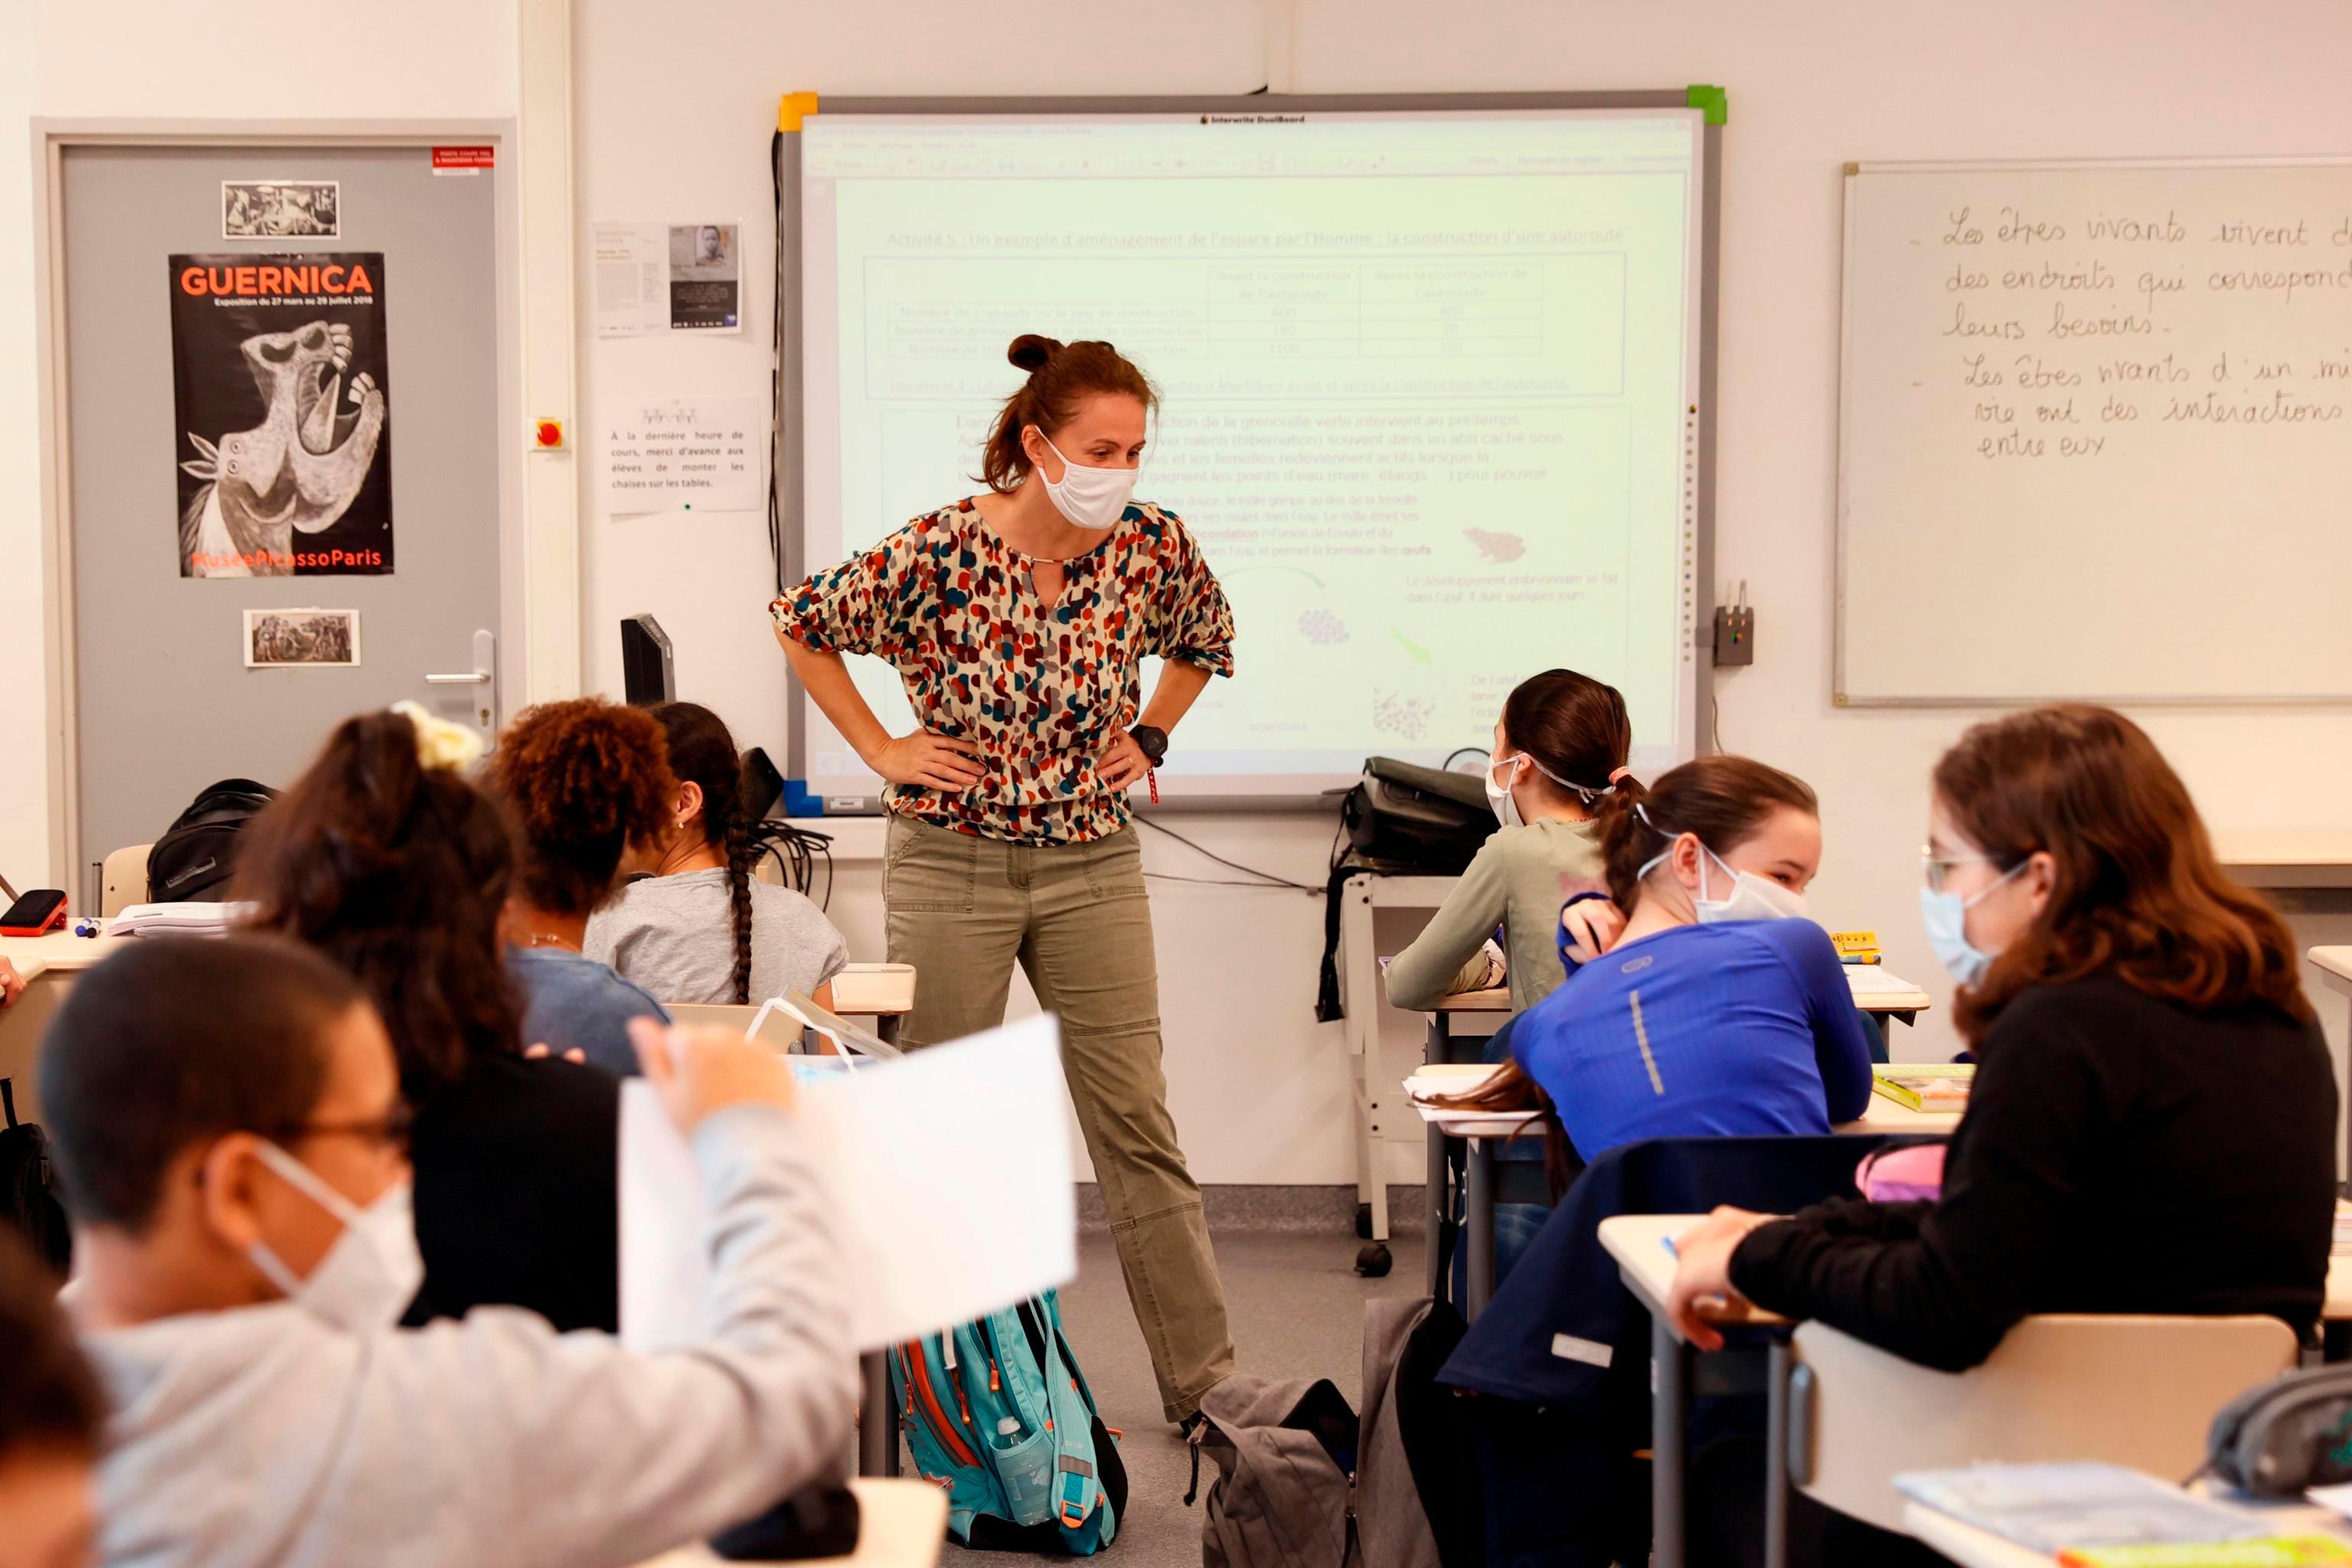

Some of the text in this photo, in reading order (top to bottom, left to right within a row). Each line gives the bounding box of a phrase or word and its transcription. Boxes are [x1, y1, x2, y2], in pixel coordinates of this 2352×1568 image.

[1257, 115, 1305, 123] DualBoard
[2087, 210, 2186, 243] vivants
[2218, 218, 2308, 246] vivent
[887, 229, 1623, 247] Activité 5 Un exemple d'aménagement de l'espace par l'Homme la construction d'une autoroute
[181, 265, 373, 296] GUERNICA
[1272, 270, 1351, 281] construction
[1429, 269, 1508, 281] construction
[1945, 263, 1990, 292] des
[2001, 260, 2115, 291] endroits
[2138, 264, 2186, 315] qui
[214, 297, 258, 307] Exposition
[259, 298, 269, 306] du
[272, 297, 282, 305] 27
[283, 297, 304, 306] mars
[329, 296, 352, 307] juillet
[1116, 307, 1195, 318] construction
[1942, 302, 2025, 340] leurs
[1962, 352, 2003, 387] Les
[2098, 352, 2190, 384] vivants
[1974, 396, 2015, 423] vie
[2101, 394, 2138, 423] des
[2161, 388, 2343, 423] interactions
[1200, 415, 1220, 427] de
[1224, 415, 1237, 427] la
[1241, 415, 1311, 431] grenouille
[1315, 415, 1351, 427] verte
[1356, 414, 1422, 427] intervient
[1426, 417, 1445, 426] au
[611, 430, 743, 440] À la dernière heure de
[1184, 430, 1563, 448] ralenti (hibernation) souvent dans un abri caché sous
[1977, 426, 2045, 459] entre
[646, 447, 673, 456] merci
[678, 447, 721, 456] d'avance
[1172, 453, 1186, 464] et
[1190, 452, 1212, 464] les
[1216, 452, 1275, 464] femelles
[1279, 452, 1373, 464] redeviennent
[1378, 451, 1415, 463] actifs
[1419, 451, 1472, 466] lorsque
[1477, 450, 1490, 462] la
[612, 462, 744, 473] élèves de monter les
[612, 480, 646, 489] chaises
[666, 479, 679, 488] les
[681, 479, 714, 488] tables.
[1150, 468, 1547, 485] gagnent les points d'eau étangs pour pouvoir
[1325, 494, 1345, 505] dos
[1348, 494, 1363, 505] de
[1365, 494, 1376, 505] la
[1271, 545, 1310, 559] permet
[1325, 544, 1376, 556] formation
[1378, 544, 1398, 556] des
[1401, 544, 1432, 556] œufs
[1406, 575, 1419, 586] Le
[1422, 574, 1507, 589] développement
[1508, 573, 1583, 588] embryonnaire
[1586, 575, 1599, 584] se
[1406, 592, 1432, 603] dans
[1479, 591, 1502, 602] dure
[1505, 590, 1555, 605] quelques
